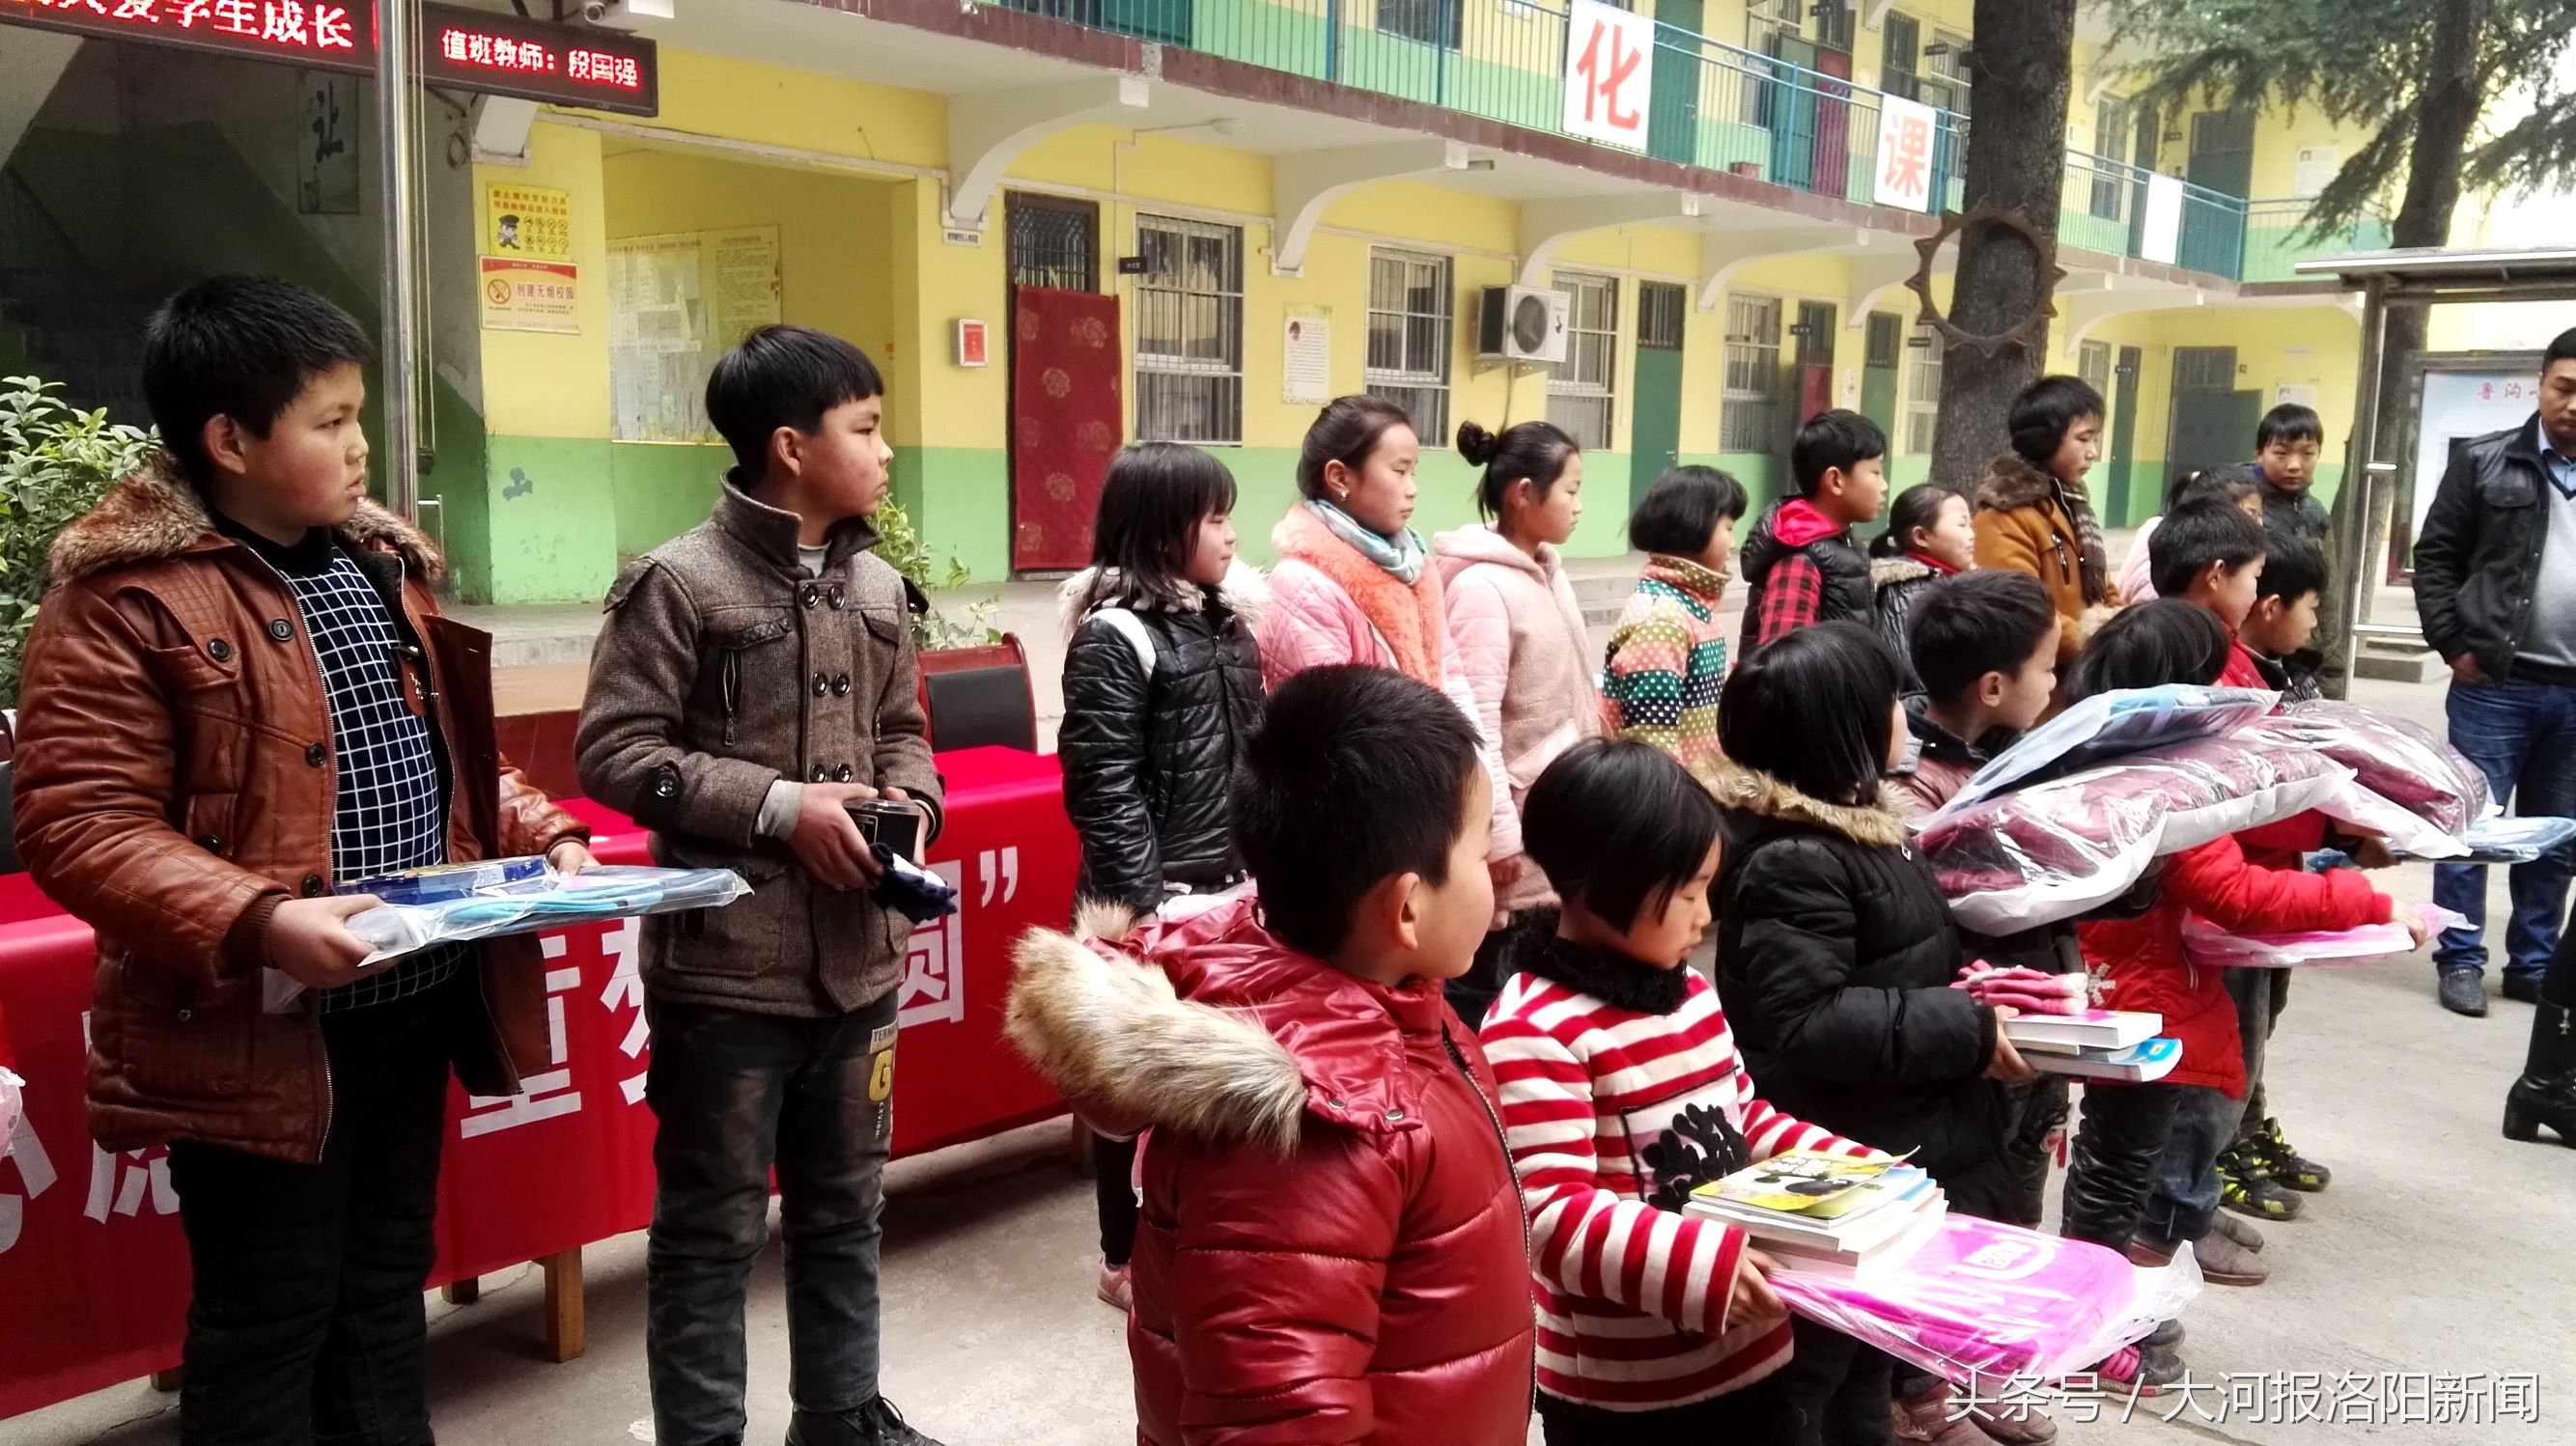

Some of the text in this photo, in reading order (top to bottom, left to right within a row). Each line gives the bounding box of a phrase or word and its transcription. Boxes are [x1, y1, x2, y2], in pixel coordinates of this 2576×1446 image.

[441, 28, 639, 88] 值班教师：段国强
[1575, 17, 1642, 131] 化
[1884, 112, 1928, 198] 课
[517, 283, 574, 300] 创建无烟校园
